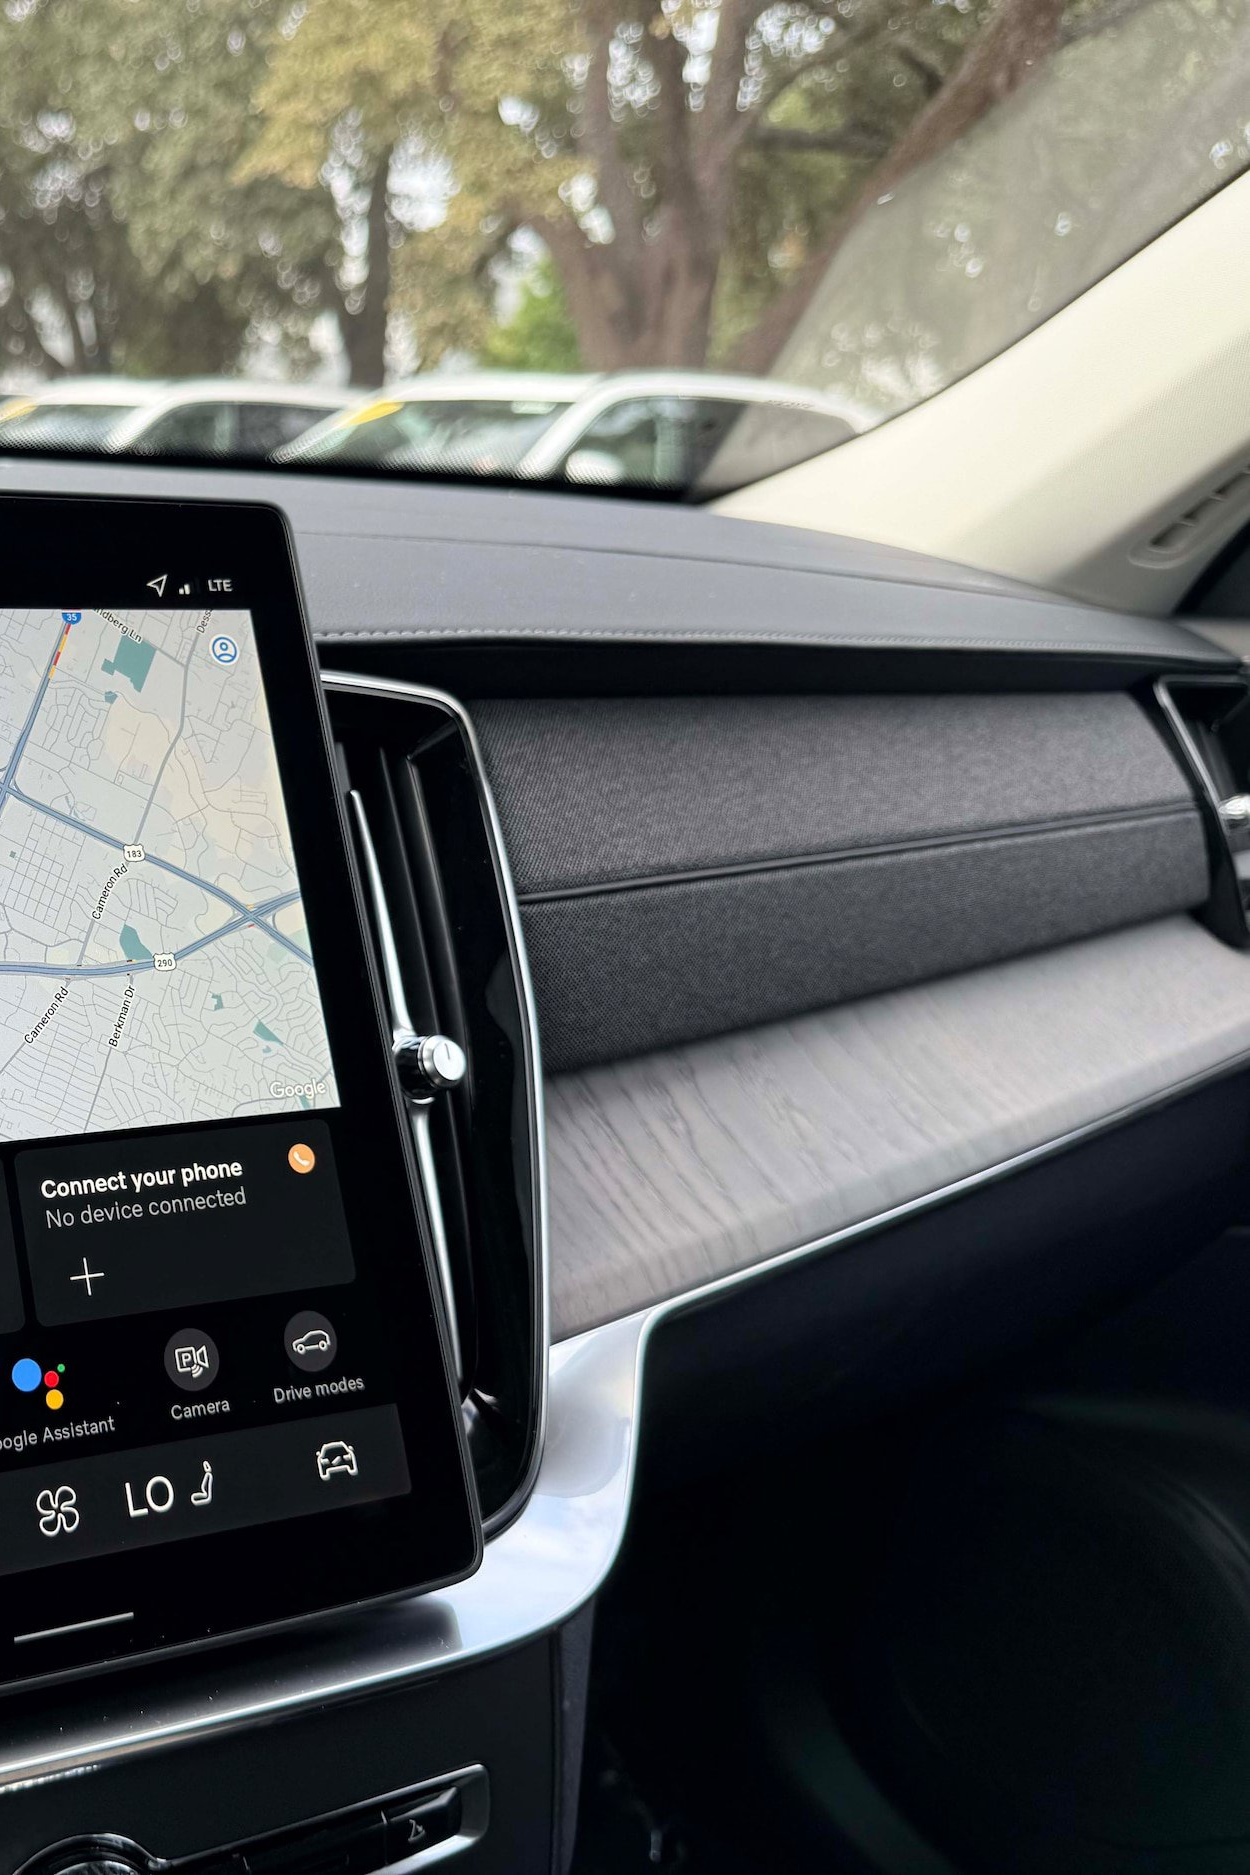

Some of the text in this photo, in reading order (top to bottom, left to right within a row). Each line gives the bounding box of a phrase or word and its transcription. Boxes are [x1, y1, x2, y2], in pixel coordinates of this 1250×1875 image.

[208, 579, 232, 592] LTE
[67, 613, 77, 621] 35
[129, 629, 142, 642] Ln
[127, 849, 142, 858] 183
[92, 863, 128, 919] Cameron Rd
[157, 958, 173, 968] 290
[24, 986, 69, 1043] Cameron Rd
[108, 985, 135, 1047] Berkman Dr
[270, 1079, 327, 1099] Google
[41, 1161, 243, 1199] Connect your phone
[46, 1186, 247, 1229] No device connected
[273, 1376, 365, 1404] Drive modes
[171, 1400, 231, 1421] Camera
[43, 1415, 116, 1443] Assistant
[124, 1475, 174, 1518] LO
